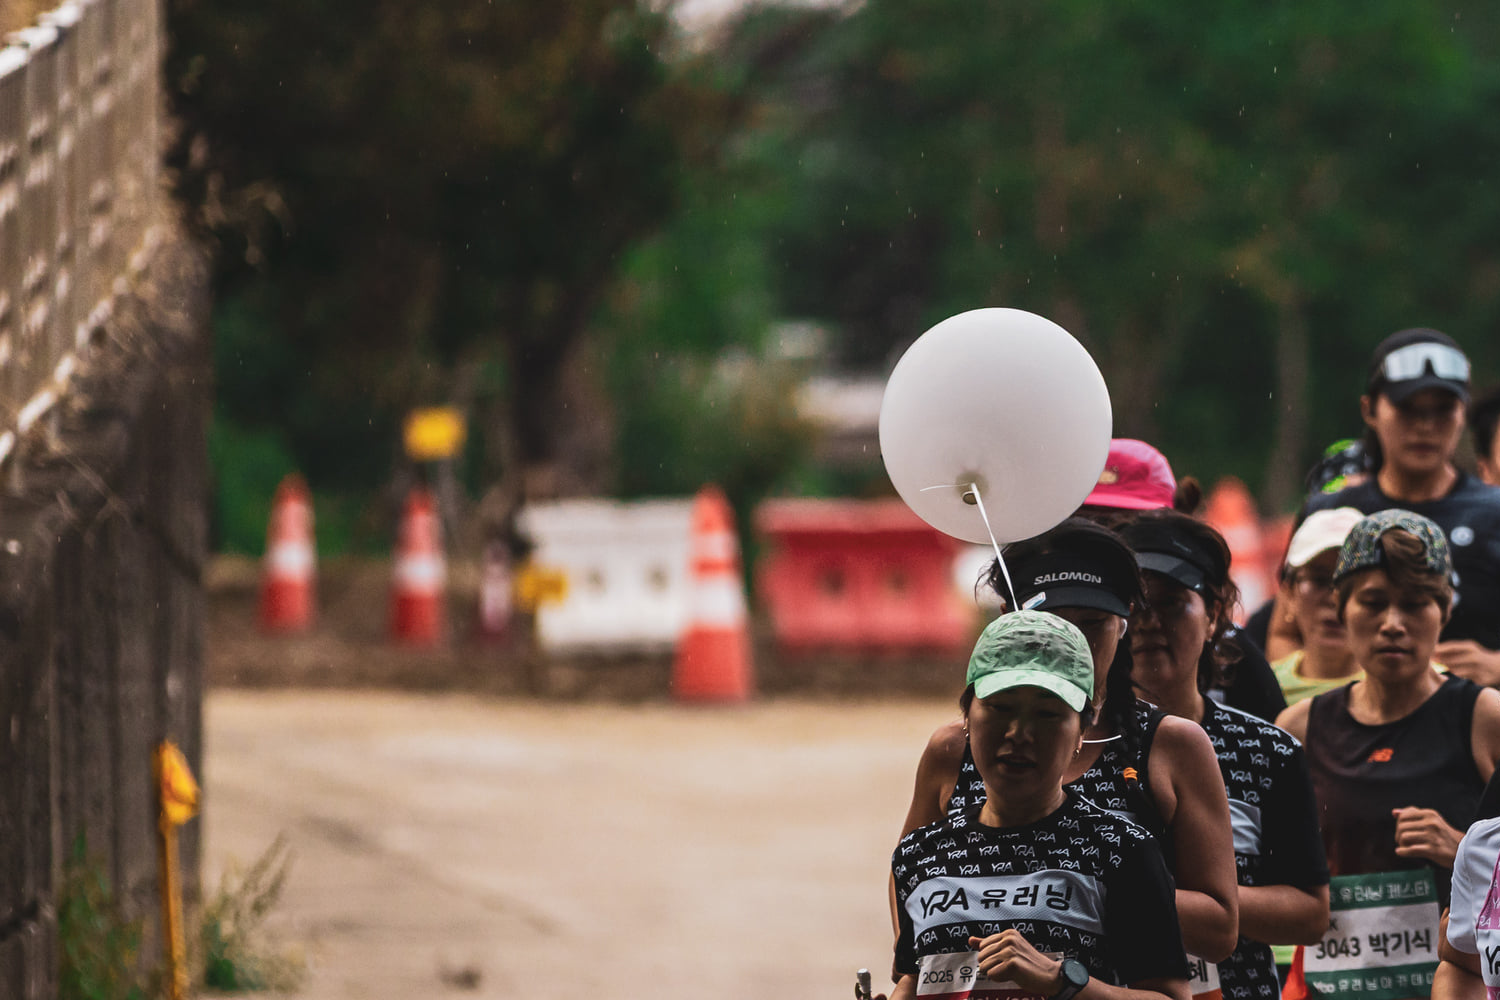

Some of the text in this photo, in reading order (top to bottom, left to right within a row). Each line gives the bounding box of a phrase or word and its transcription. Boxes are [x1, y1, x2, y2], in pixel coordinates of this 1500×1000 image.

[1034, 571, 1102, 585] SALOMON
[1083, 769, 1102, 779] YRA
[1230, 770, 1252, 783] YRA
[1095, 782, 1115, 792] YRA
[1106, 798, 1127, 809] YRA
[1033, 830, 1056, 843] YRA
[947, 845, 1035, 859] YRA YRA YRA
[925, 860, 1080, 876] YRA YRA YRA YRA YRA
[920, 884, 1072, 919] YRA 유러닝
[946, 922, 1070, 939] YRA YRA YRA YRA
[1316, 928, 1431, 959] 3043 박기식
[922, 970, 954, 984] 2025
